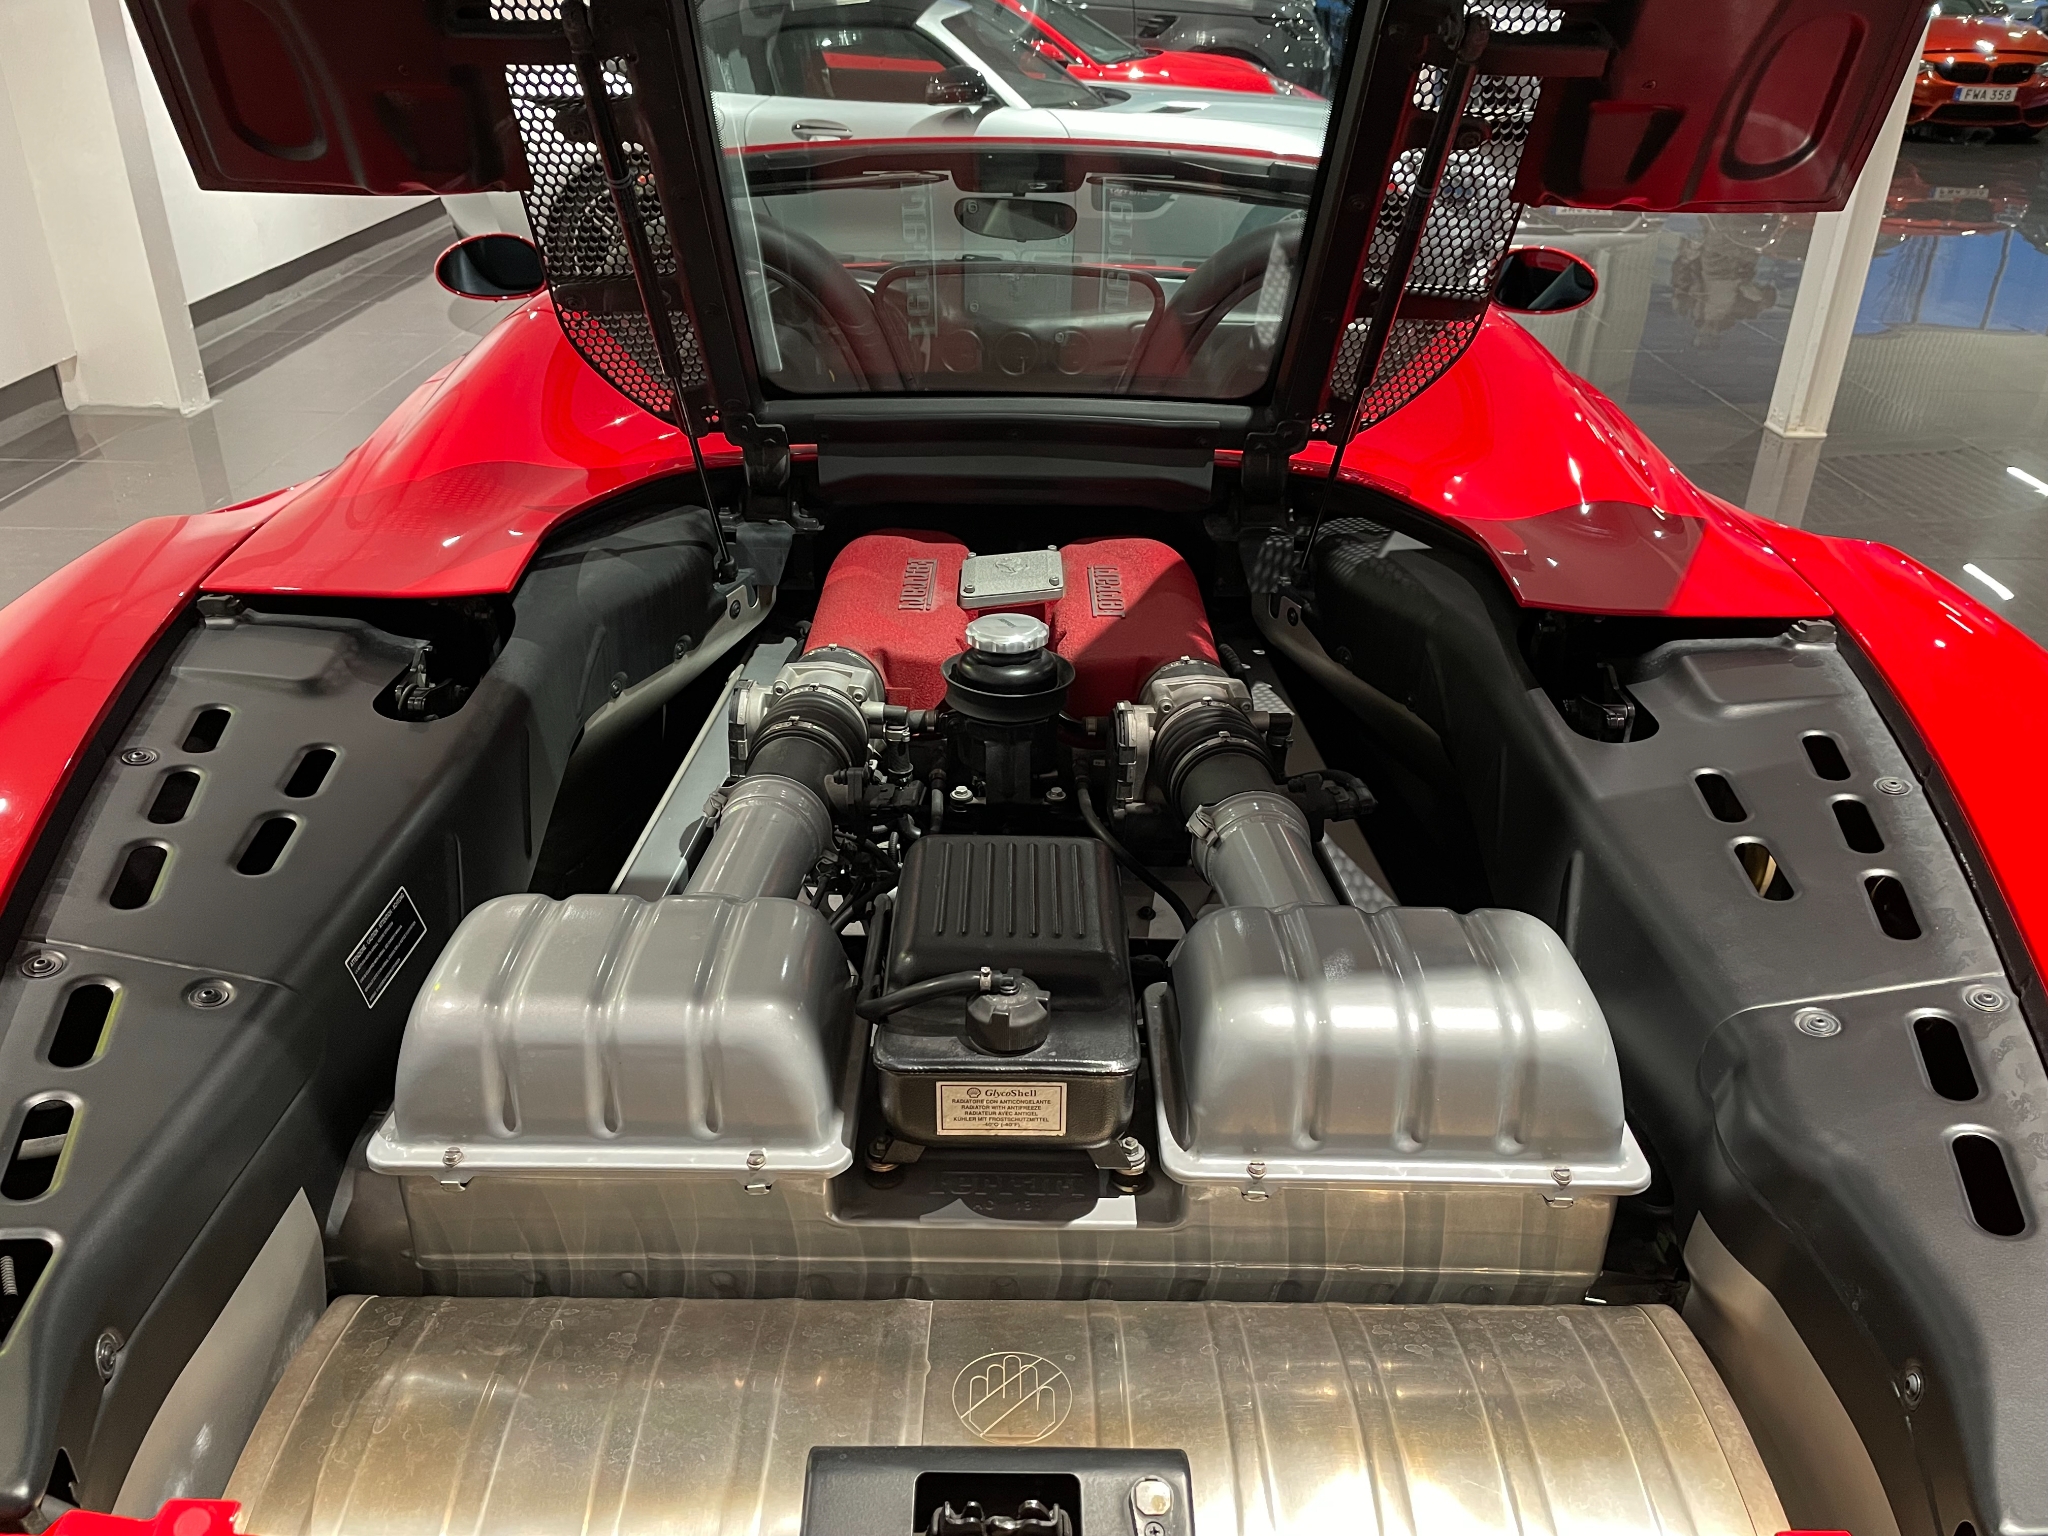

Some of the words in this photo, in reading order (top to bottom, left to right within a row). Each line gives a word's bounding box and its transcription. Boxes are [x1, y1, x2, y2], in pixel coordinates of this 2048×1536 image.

[1964, 89, 1987, 100] FWA
[1989, 89, 2012, 101] 358
[898, 558, 938, 612] Ferrari
[1087, 564, 1126, 619] Ferrari
[984, 1089, 1037, 1098] GlycoShell
